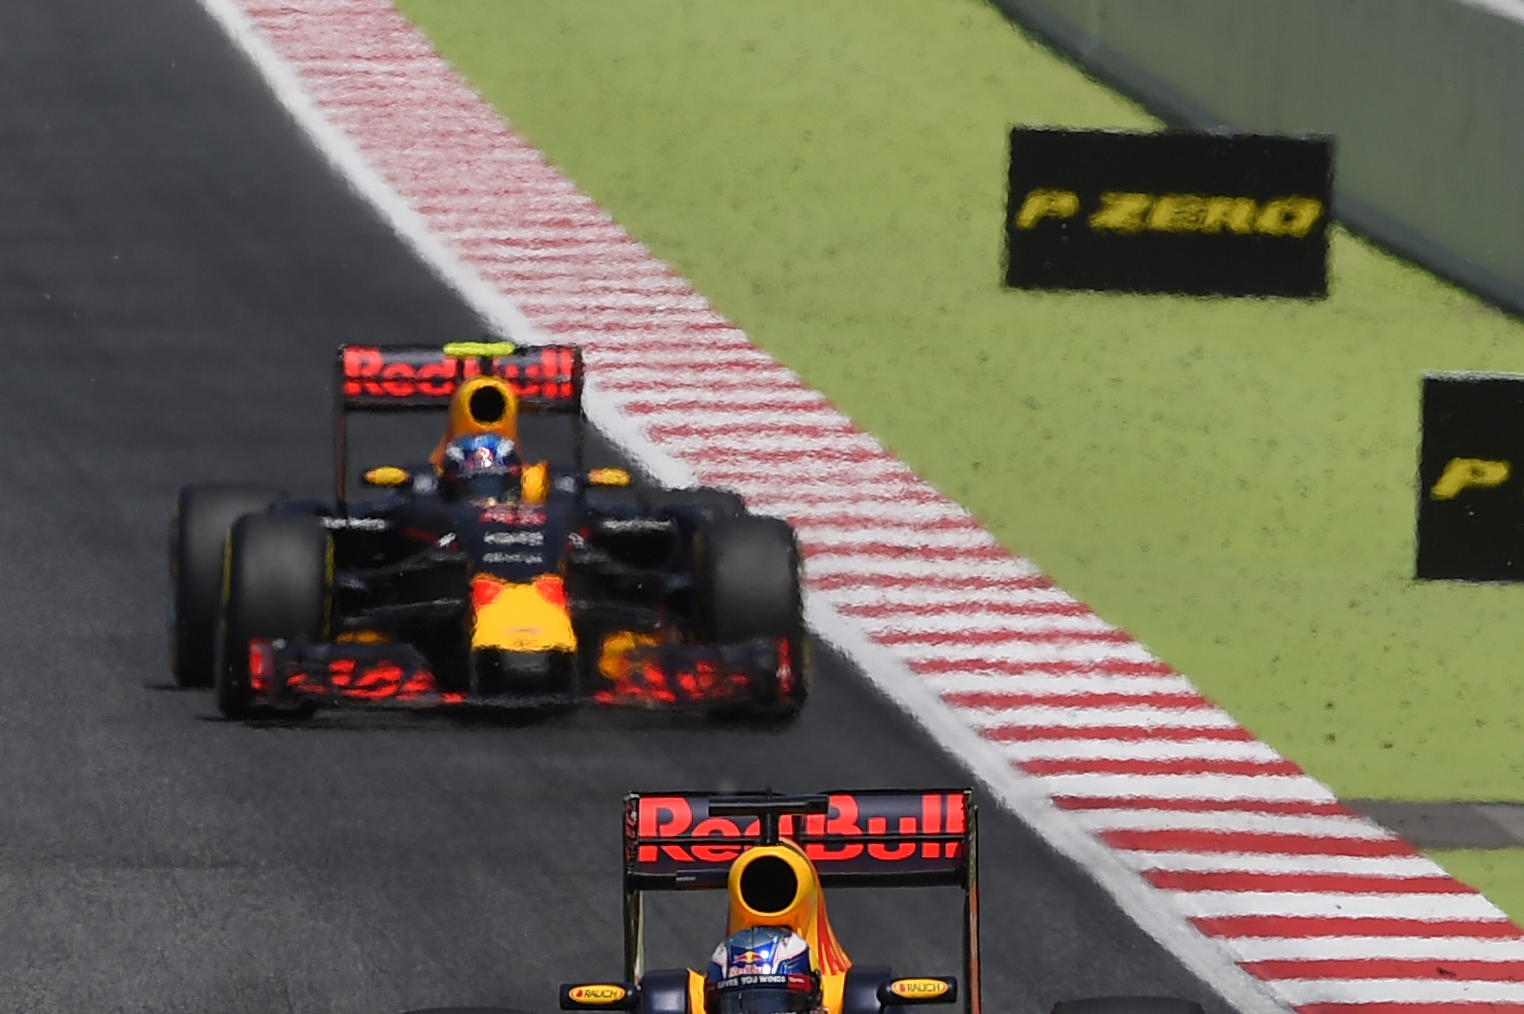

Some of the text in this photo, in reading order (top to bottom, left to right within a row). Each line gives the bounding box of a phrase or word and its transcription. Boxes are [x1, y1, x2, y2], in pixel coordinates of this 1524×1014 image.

[1016, 189, 1324, 238] P ZERO
[1431, 457, 1511, 500] P
[806, 794, 967, 861] Bull
[584, 990, 619, 999] RAUCH
[906, 983, 941, 993] RAUCH
